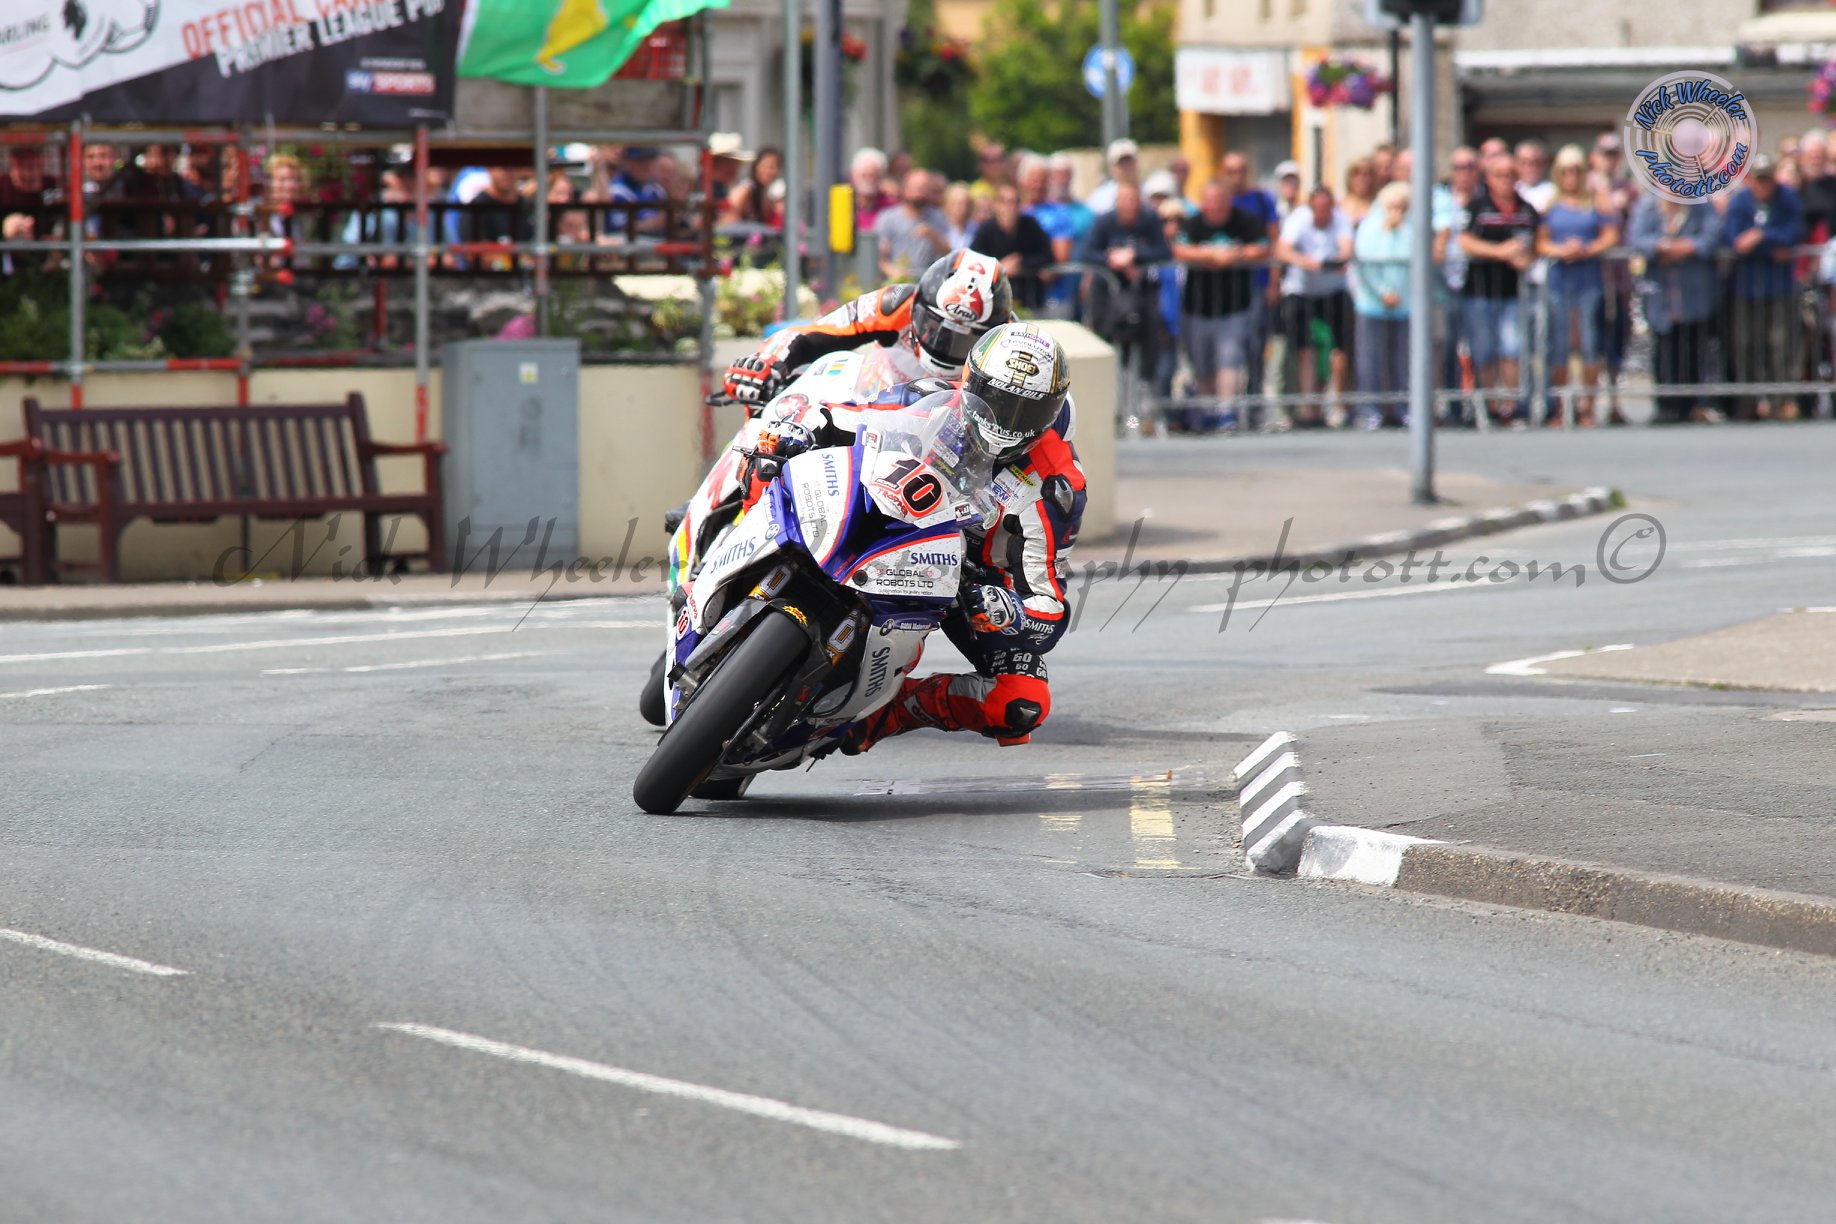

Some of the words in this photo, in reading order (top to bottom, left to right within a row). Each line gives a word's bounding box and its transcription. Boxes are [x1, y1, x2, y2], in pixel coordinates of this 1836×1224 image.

[949, 304, 977, 320] Arai
[1007, 358, 1037, 375] SHOEI
[987, 378, 1023, 395] NOLAN
[821, 453, 840, 497] SMITHS
[880, 458, 943, 515] 10
[814, 489, 827, 527] GLOBAL
[710, 536, 757, 574] SMITHS
[910, 552, 959, 567] SMITHS
[886, 569, 925, 577] GLOBAL
[876, 579, 916, 587] ROBOTS
[917, 579, 934, 589] LTD
[1025, 619, 1055, 634] SMITHS
[864, 646, 891, 698] SMITHS
